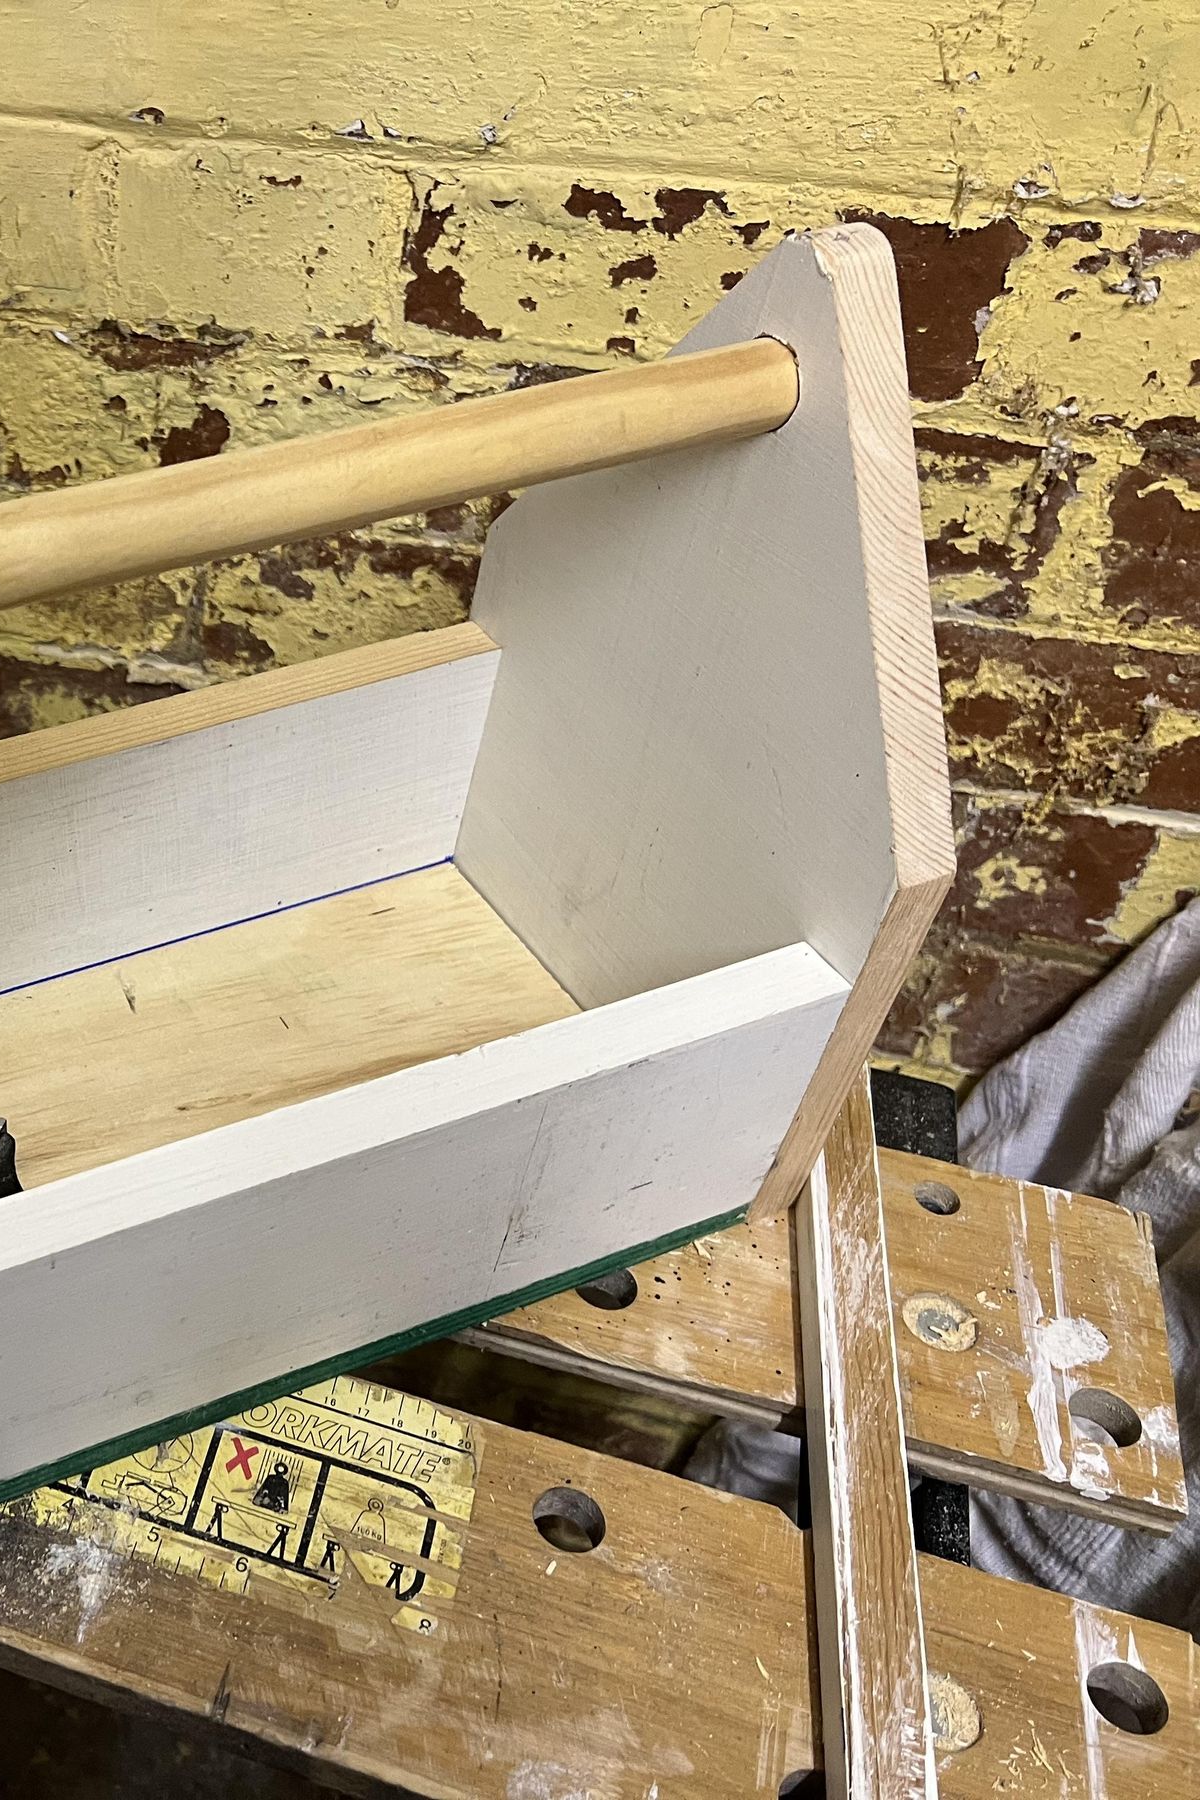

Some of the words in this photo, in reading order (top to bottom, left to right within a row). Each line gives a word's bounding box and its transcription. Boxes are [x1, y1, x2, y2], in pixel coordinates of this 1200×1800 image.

[324, 1396, 337, 1407] 16
[357, 1407, 370, 1418] 17
[390, 1417, 403, 1428] 18
[424, 1428, 438, 1439] 19
[457, 1439, 472, 1450] 20
[146, 1526, 161, 1543] 5
[234, 1556, 249, 1573] 6
